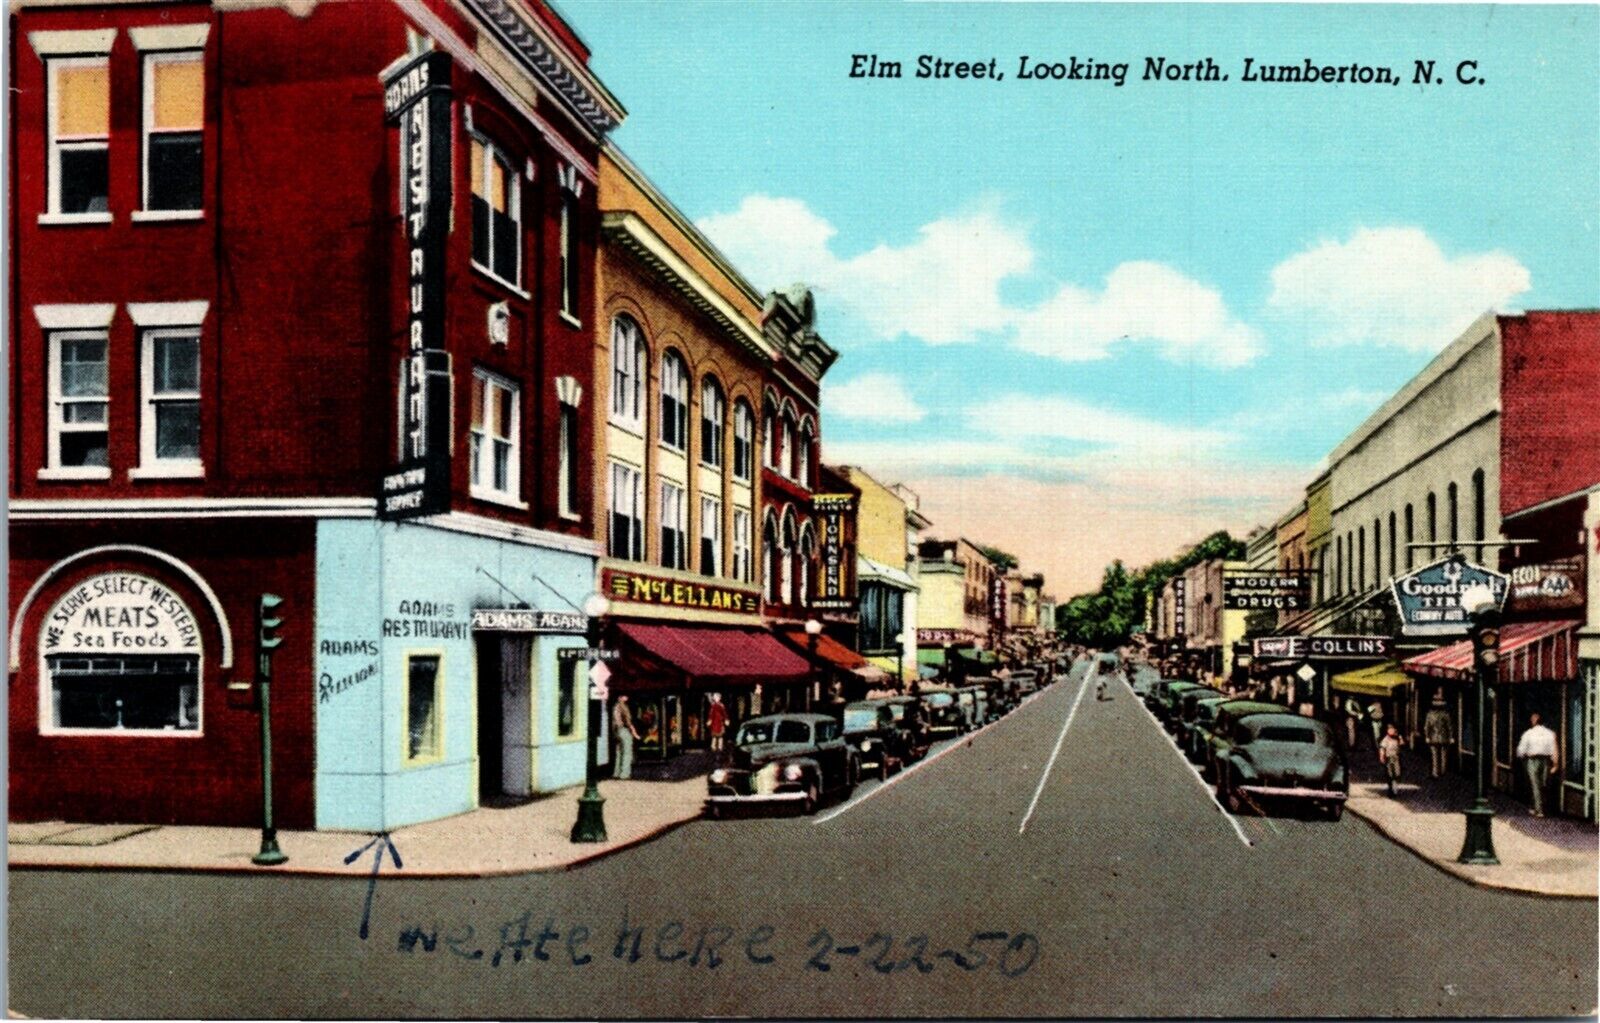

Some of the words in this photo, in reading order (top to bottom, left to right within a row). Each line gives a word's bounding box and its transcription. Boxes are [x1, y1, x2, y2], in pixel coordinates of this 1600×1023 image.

[826, 514, 838, 597] TOWNSEND
[1235, 578, 1299, 587] MODERN
[1402, 576, 1502, 597] Goodrh
[1237, 597, 1297, 608] DRUGS
[46, 626, 65, 649] WE
[94, 576, 148, 598] SELECT
[149, 585, 197, 647] WESTERN
[82, 605, 160, 628] MEATS
[471, 612, 533, 629] ADAMS
[73, 632, 105, 648] Sea
[112, 631, 169, 648] Foods
[320, 639, 379, 656] ADAMS
[1311, 640, 1386, 654] COLLINS
